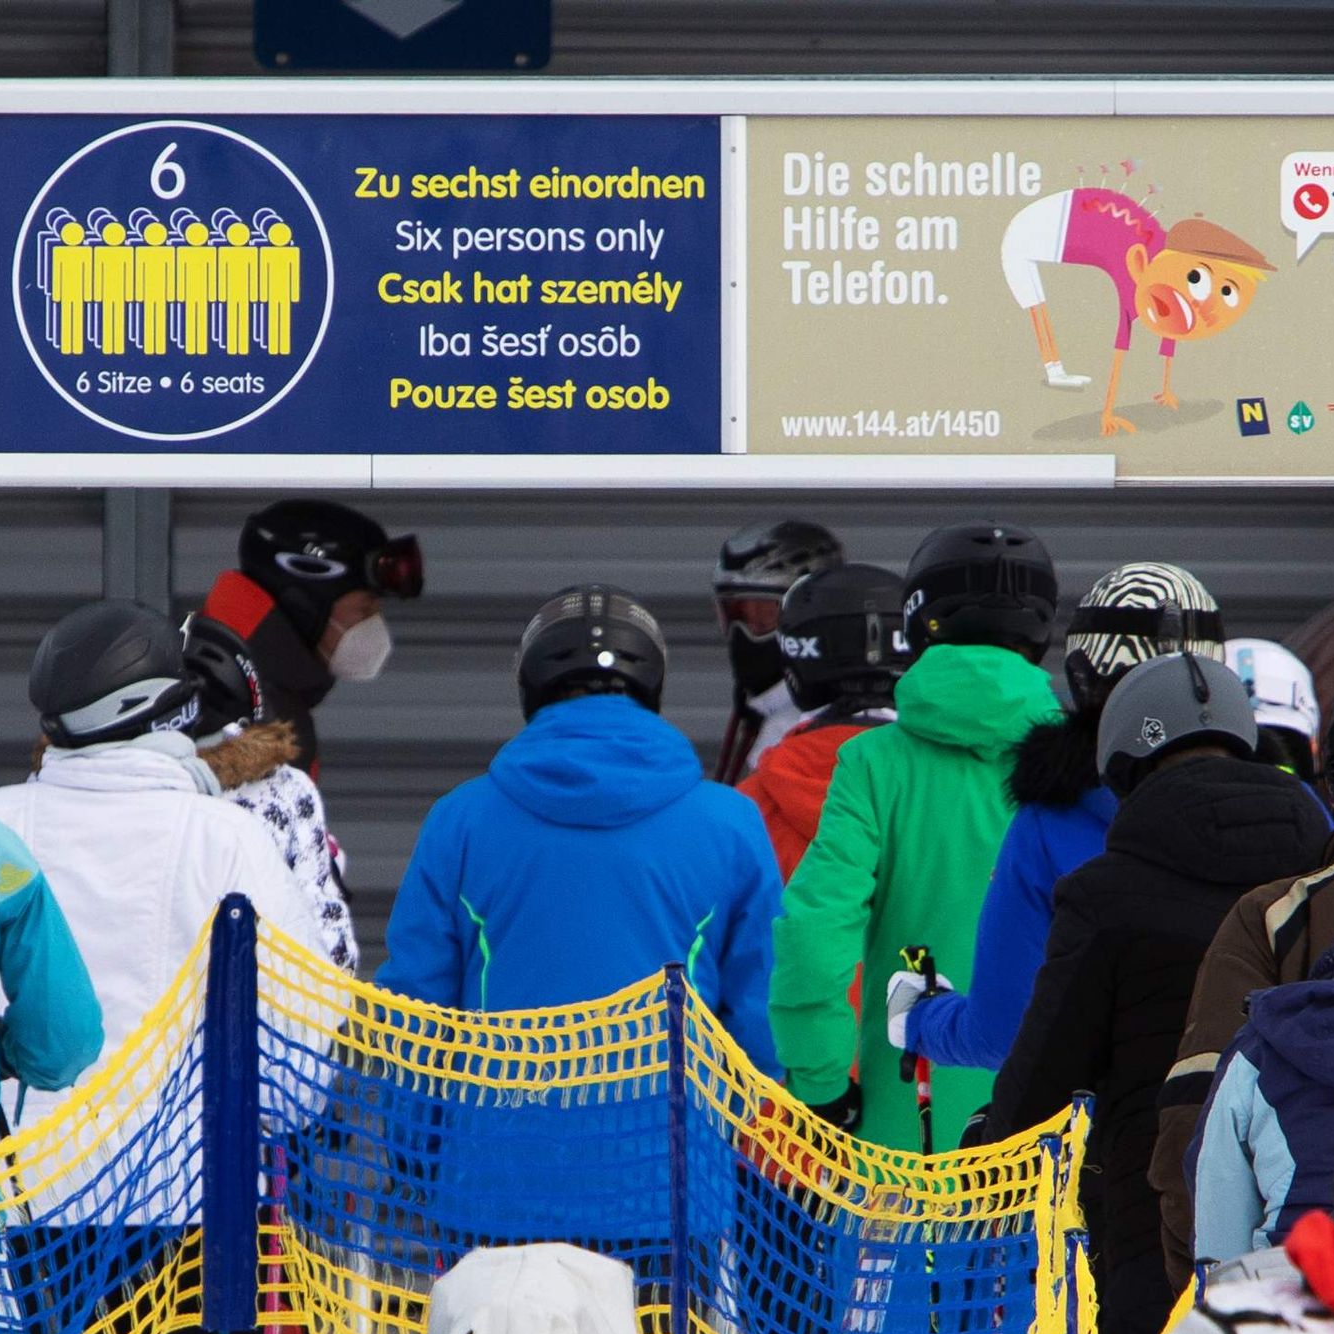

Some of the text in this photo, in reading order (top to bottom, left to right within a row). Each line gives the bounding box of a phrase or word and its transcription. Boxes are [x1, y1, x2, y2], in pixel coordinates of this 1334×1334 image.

[151, 143, 186, 200] 6
[355, 166, 705, 198] Zu sechst einordnen
[783, 152, 1041, 195] Die schnelle
[396, 220, 665, 260] Six persons only
[783, 206, 958, 250] Hilfe am
[378, 271, 682, 312] Csak hat személy
[782, 261, 948, 304] Telefon.
[420, 324, 640, 356] Iba šesť osôb
[76, 371, 265, 393] 6 Sitze 6 seats
[390, 377, 670, 409] Pouze šest osob
[782, 411, 1000, 437] www.144.at/1450
[152, 696, 198, 731] boll
